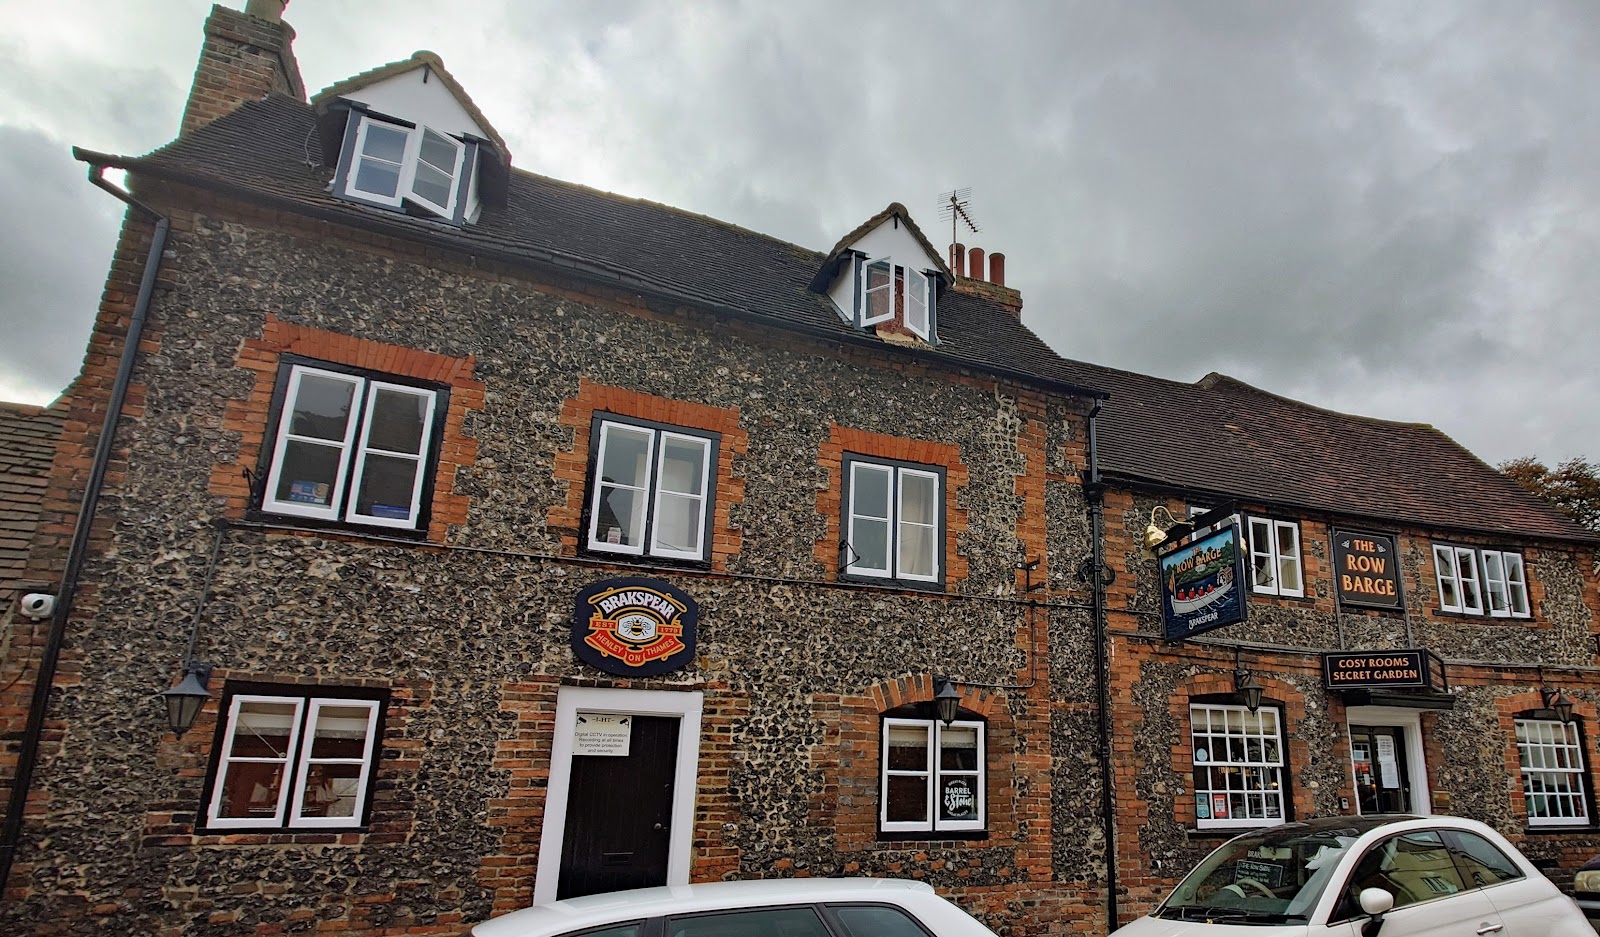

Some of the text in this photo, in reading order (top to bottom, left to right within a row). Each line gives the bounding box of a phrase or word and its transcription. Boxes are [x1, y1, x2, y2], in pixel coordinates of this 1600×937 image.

[1353, 539, 1376, 552] THE
[1177, 558, 1194, 573] ROW
[1196, 549, 1221, 565] BARGE
[1346, 554, 1386, 574] ROW
[1342, 574, 1396, 596] BARGE
[599, 591, 675, 620] BRAKSPEAR
[1189, 612, 1218, 630] BRAKSPEAR
[596, 633, 675, 662] HENLEY ON THAMES
[1338, 657, 1409, 668] COSY ROOMS
[1333, 669, 1417, 680] SECRET GARDEN
[949, 793, 972, 811] Stone
